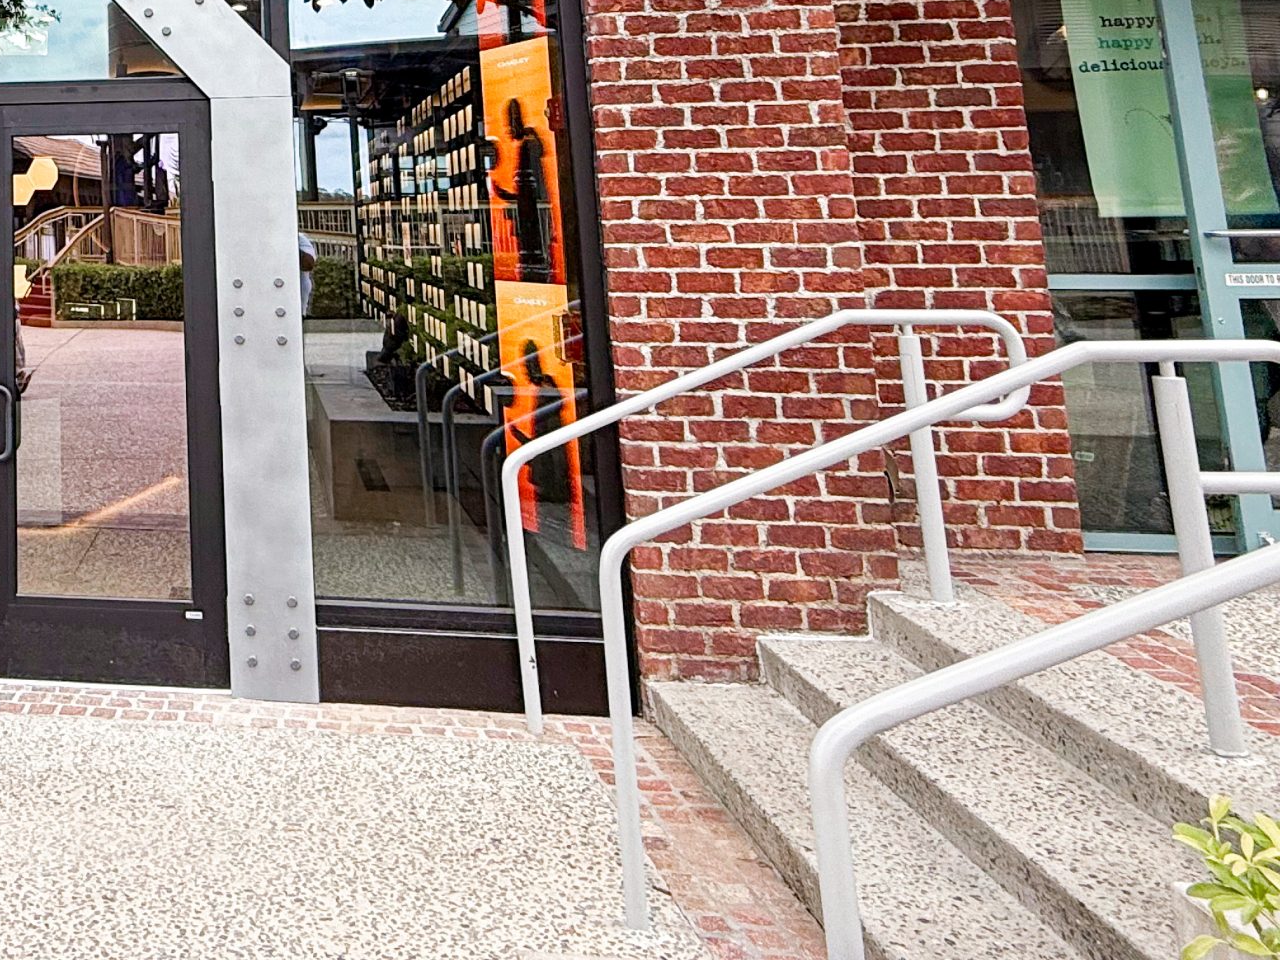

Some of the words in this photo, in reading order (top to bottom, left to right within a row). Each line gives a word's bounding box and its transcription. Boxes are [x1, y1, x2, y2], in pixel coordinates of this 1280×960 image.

[1099, 15, 1156, 29] happy
[1098, 37, 1154, 50] happy
[1228, 274, 1244, 284] THIS
[1245, 274, 1264, 284] DOOR
[1265, 274, 1275, 284] TO
